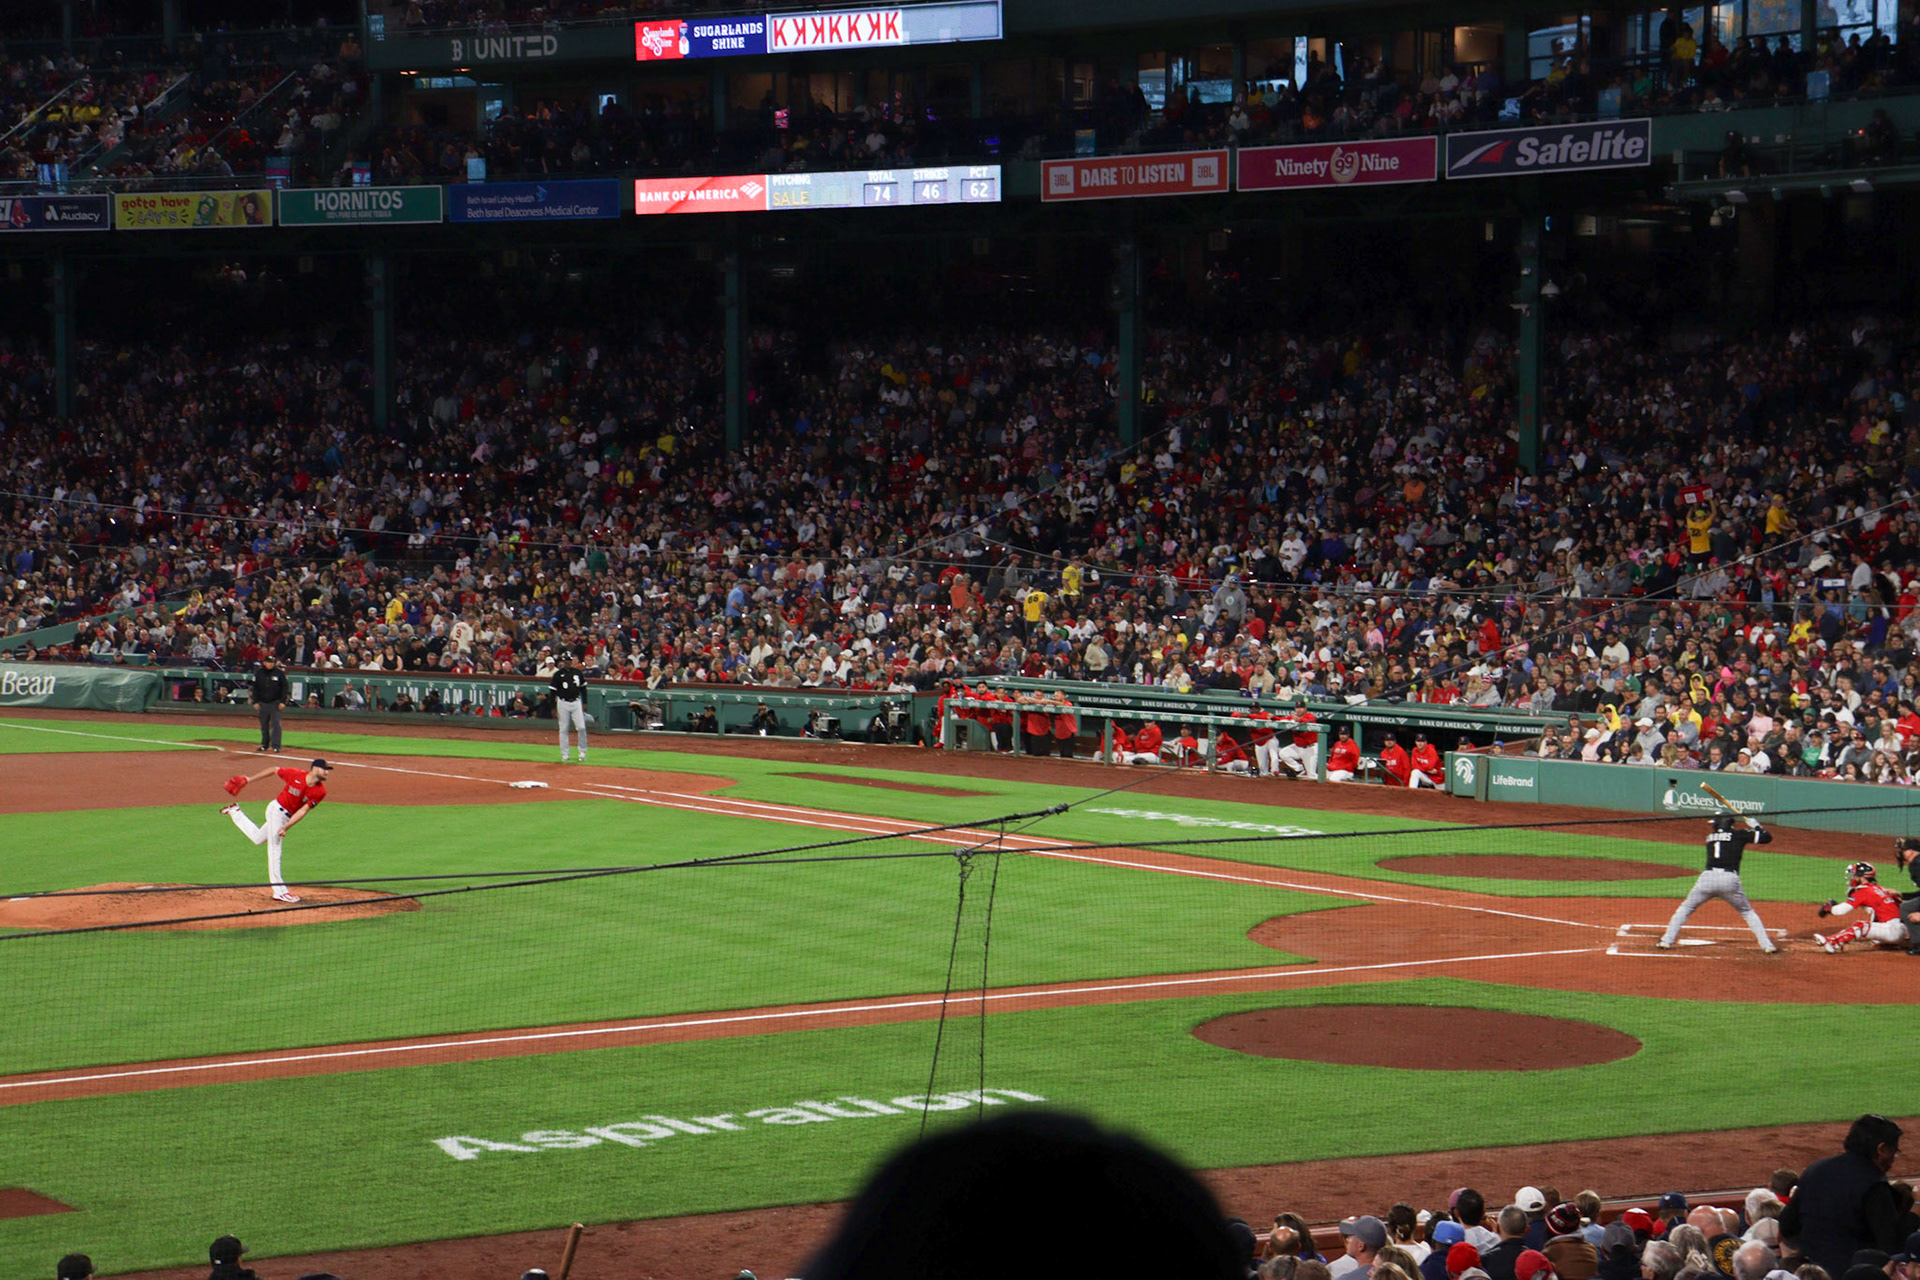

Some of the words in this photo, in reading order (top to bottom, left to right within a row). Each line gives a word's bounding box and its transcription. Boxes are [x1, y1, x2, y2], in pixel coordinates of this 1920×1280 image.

[694, 22, 763, 38] SUGARLANDS
[712, 37, 745, 50] SHINE
[1515, 128, 1645, 166] Safelite
[1275, 158, 1329, 178] Ninety
[1336, 154, 1354, 173] 99
[1361, 153, 1399, 172] Nine
[867, 171, 895, 182] TOTAL
[913, 169, 949, 181] STRIKES
[970, 167, 988, 178] PCT
[1080, 167, 1118, 187] DARE
[1120, 166, 1135, 185] TO
[1137, 163, 1185, 184] LISTEN
[467, 196, 480, 204] Beth
[515, 194, 535, 203] Health
[640, 191, 669, 202] BANK
[671, 191, 685, 202] OF
[688, 189, 739, 201] AMERICA
[773, 191, 809, 206] SALE
[873, 186, 891, 202] 74
[922, 184, 940, 199] 46
[970, 182, 988, 197] 62
[122, 198, 156, 211] gotta
[161, 196, 190, 207] have
[314, 190, 403, 211] HORNITOS
[60, 212, 101, 223] Audacy
[467, 208, 484, 218] Beth
[485, 207, 503, 217] Israel
[505, 206, 543, 217] Deaconess
[544, 206, 572, 216] Medical
[573, 205, 599, 216] Center
[1, 671, 56, 695] Bean
[1100, 697, 1121, 705] AMERICA
[1370, 716, 1395, 724] AMERICA
[1419, 719, 1435, 727] BANK
[1435, 720, 1443, 728] OF
[1444, 721, 1470, 729] AMERICA
[1495, 725, 1513, 733] BANK
[1492, 774, 1534, 788] LifeBrand
[1680, 792, 1714, 807] Ockers
[1713, 841, 1720, 859] 1
[434, 1089, 1046, 1160] Aspiration
